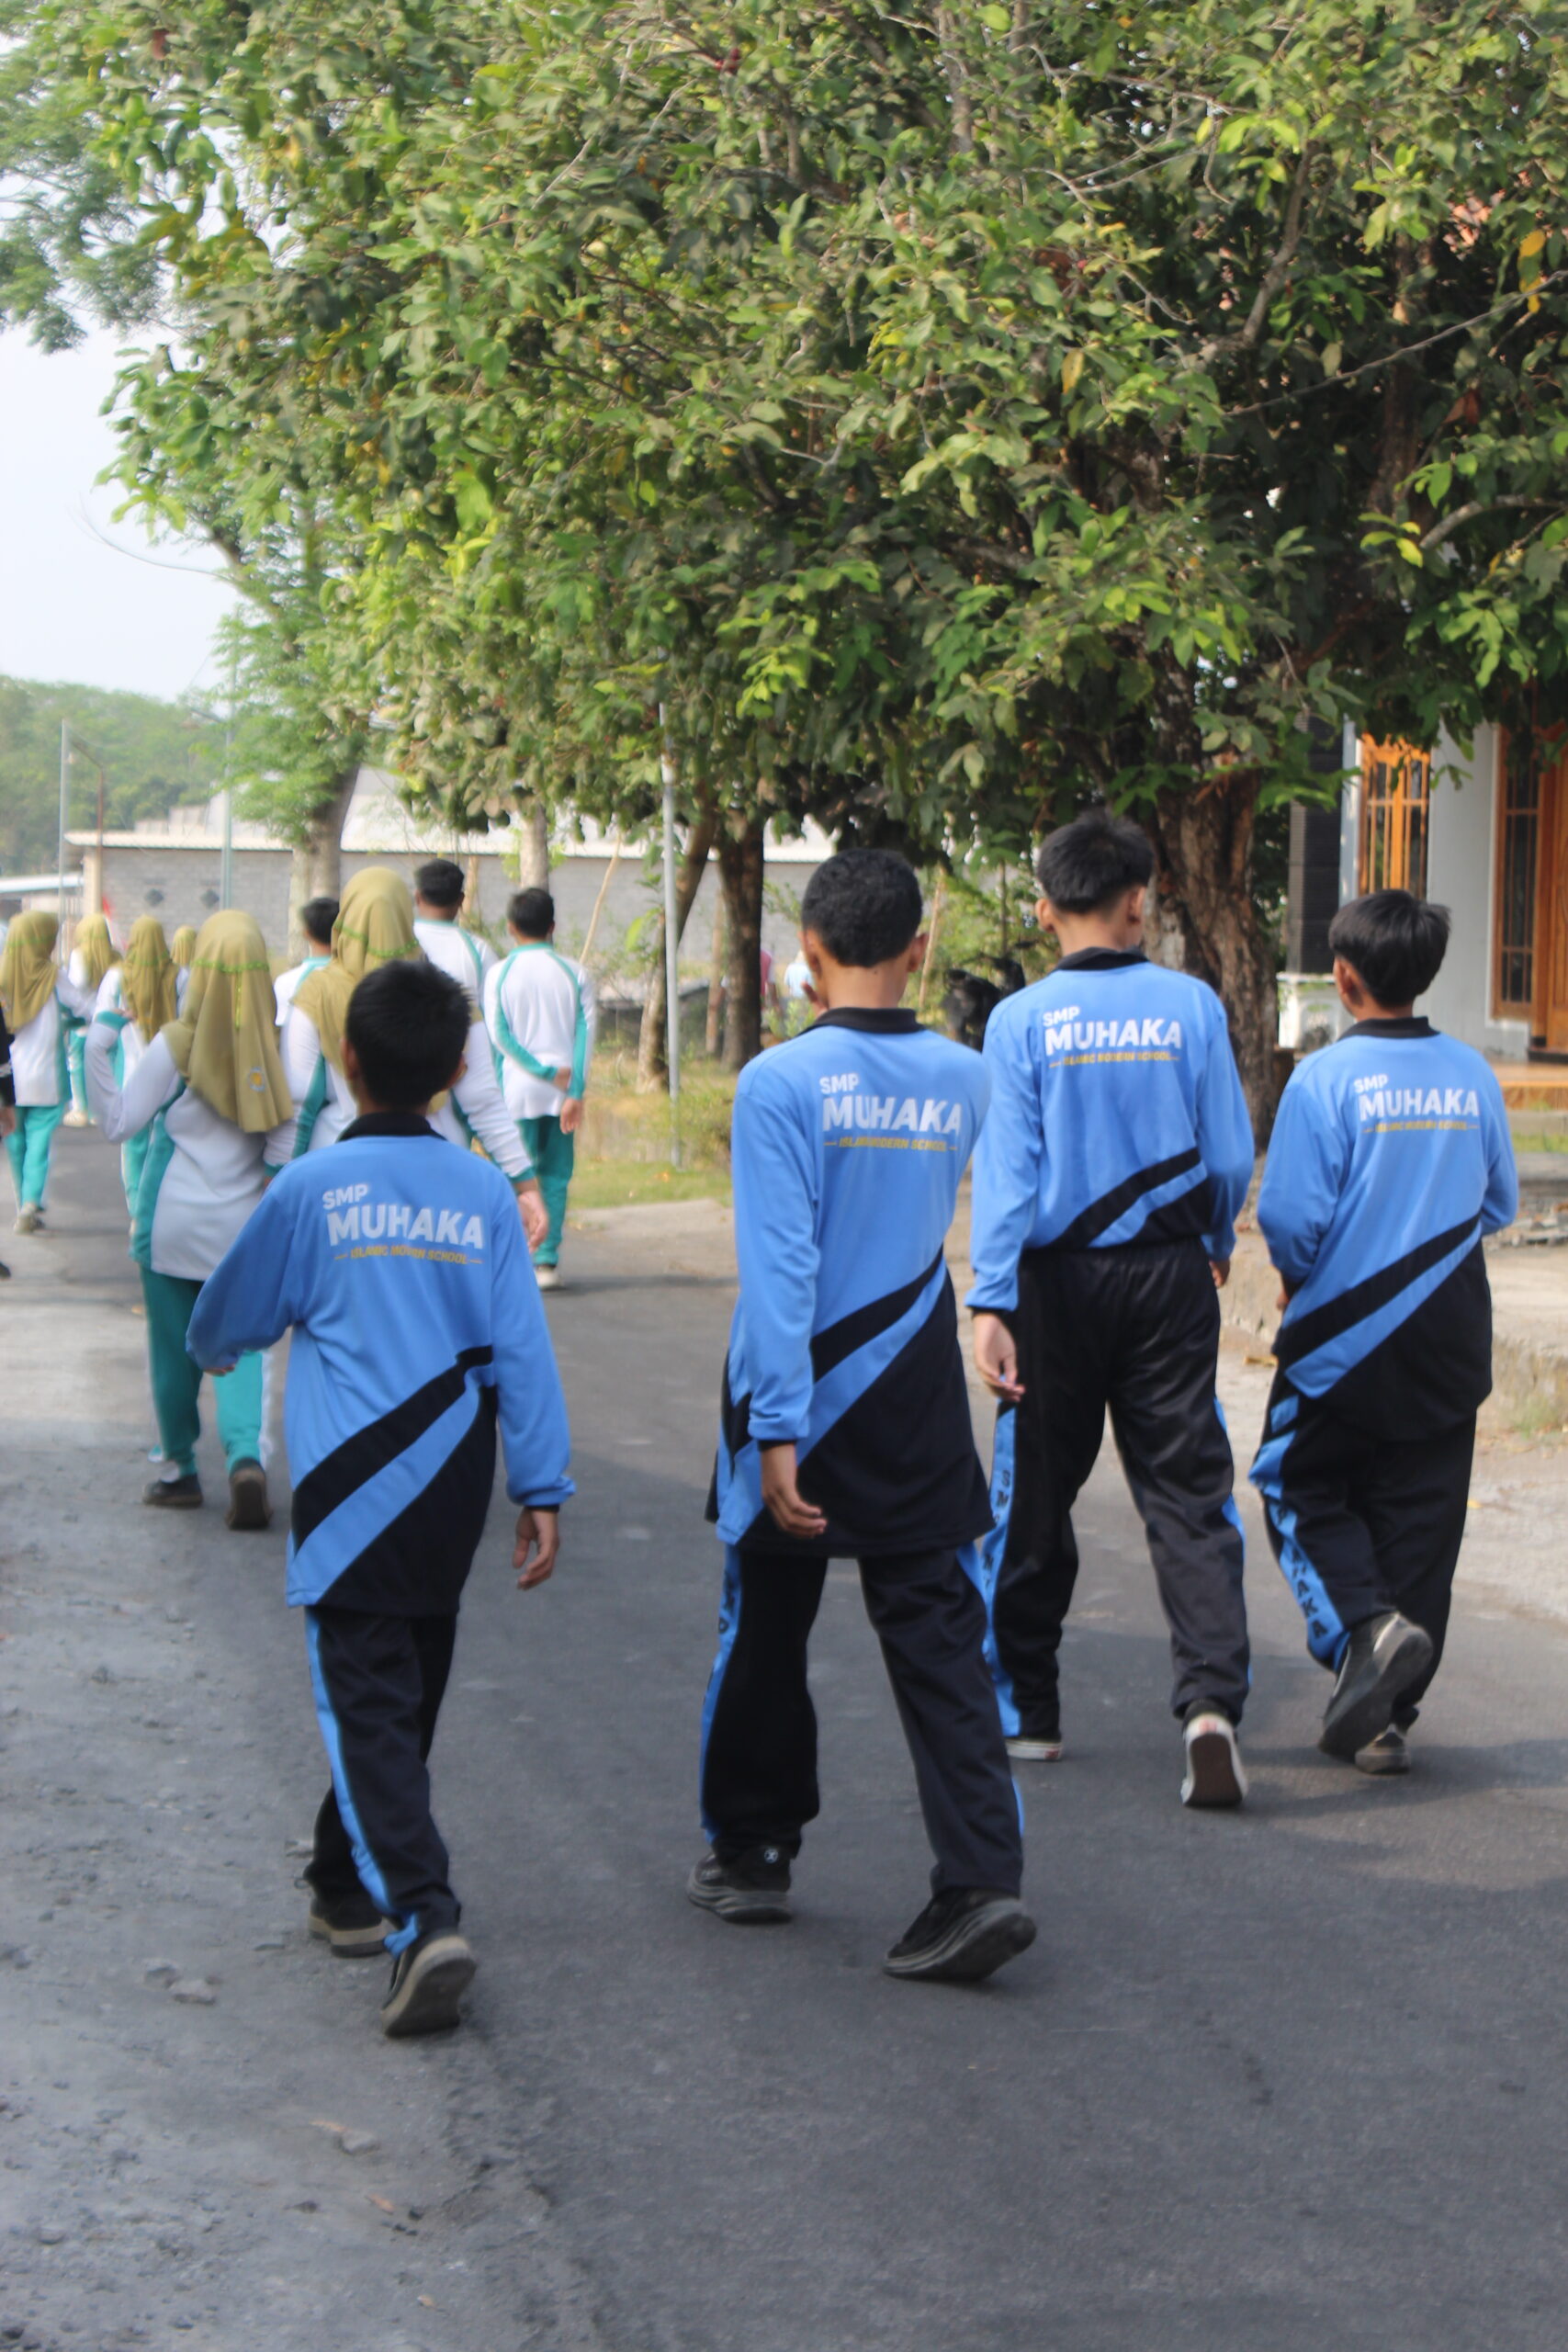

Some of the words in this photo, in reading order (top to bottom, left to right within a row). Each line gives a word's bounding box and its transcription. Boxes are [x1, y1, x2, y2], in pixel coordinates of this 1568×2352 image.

[1043, 1006, 1080, 1026] SMP
[1044, 1018, 1182, 1056] MUHAKA
[819, 1072, 860, 1094] SMP
[1354, 1074, 1389, 1093] SMP
[822, 1094, 963, 1136] MUHAKA
[1359, 1088, 1480, 1122] MUHAKA
[322, 1183, 369, 1210] SMP
[327, 1204, 484, 1250] MUHAKA
